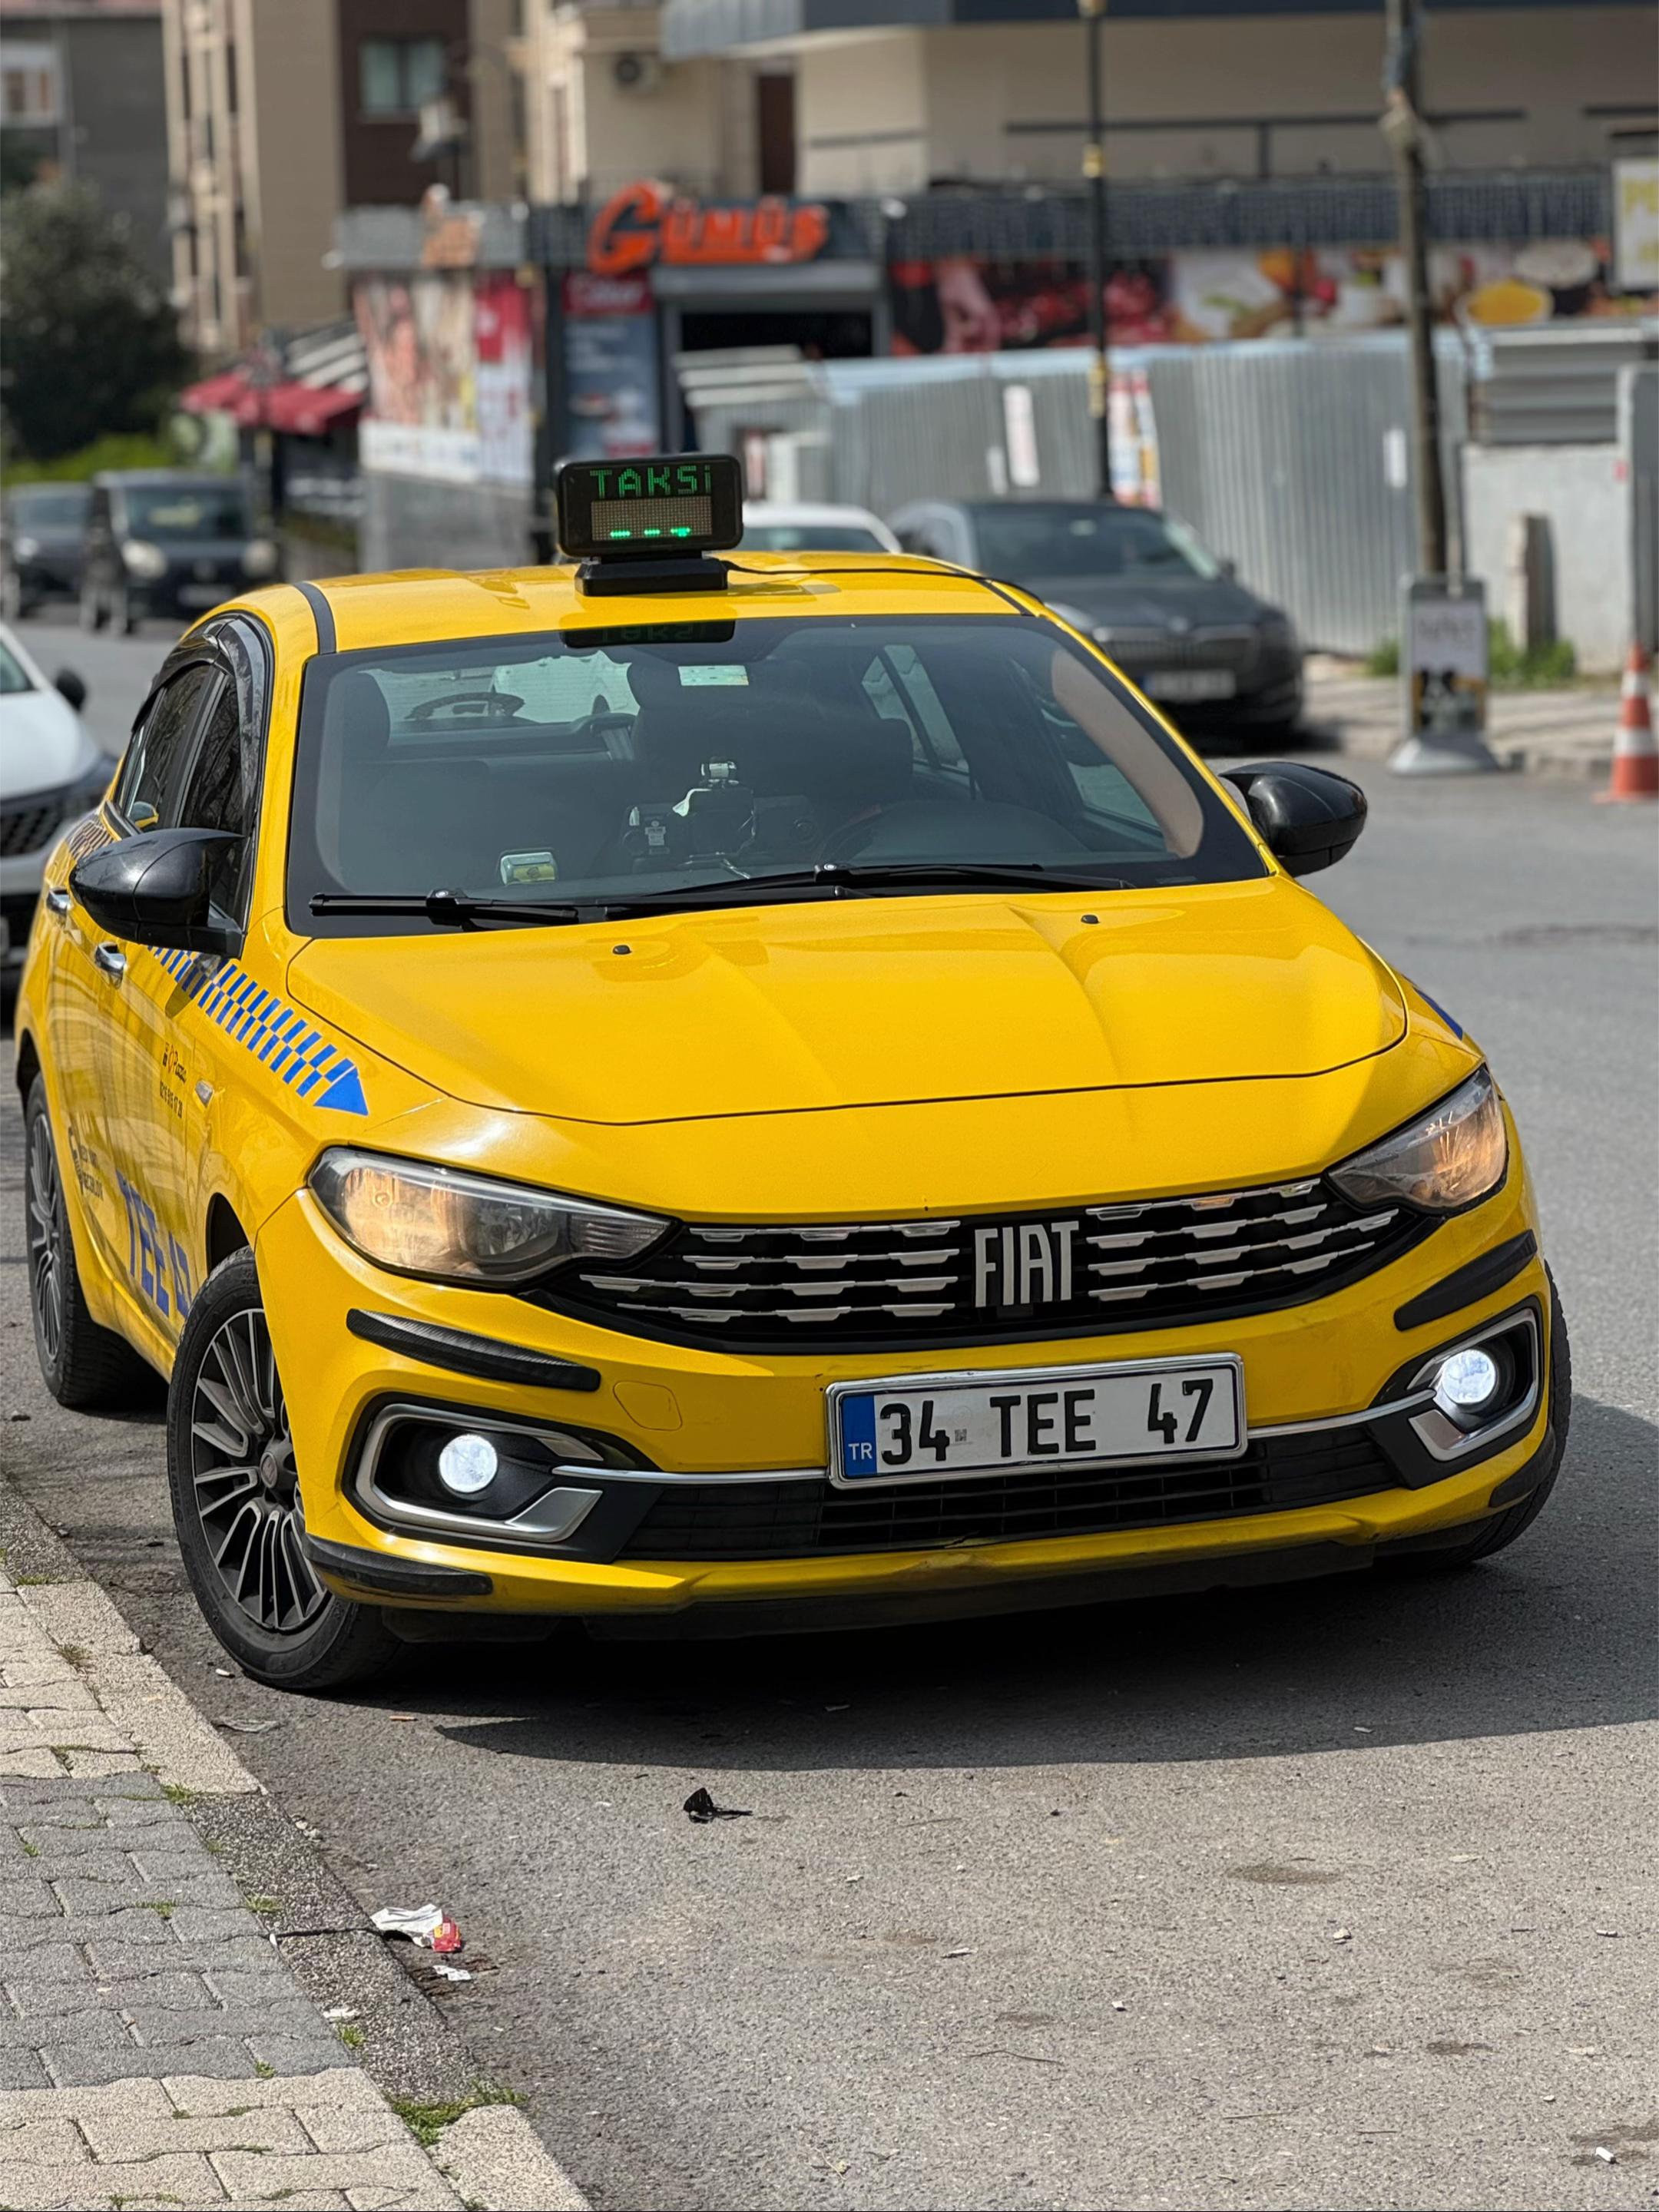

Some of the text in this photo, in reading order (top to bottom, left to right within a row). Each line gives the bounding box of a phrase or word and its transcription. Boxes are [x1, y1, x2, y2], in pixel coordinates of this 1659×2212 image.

[116, 1168, 170, 1317] TEE
[975, 1220, 1079, 1308] FIAT
[848, 1442, 873, 1460] TR
[879, 1378, 1214, 1465] 34 TEE 47
